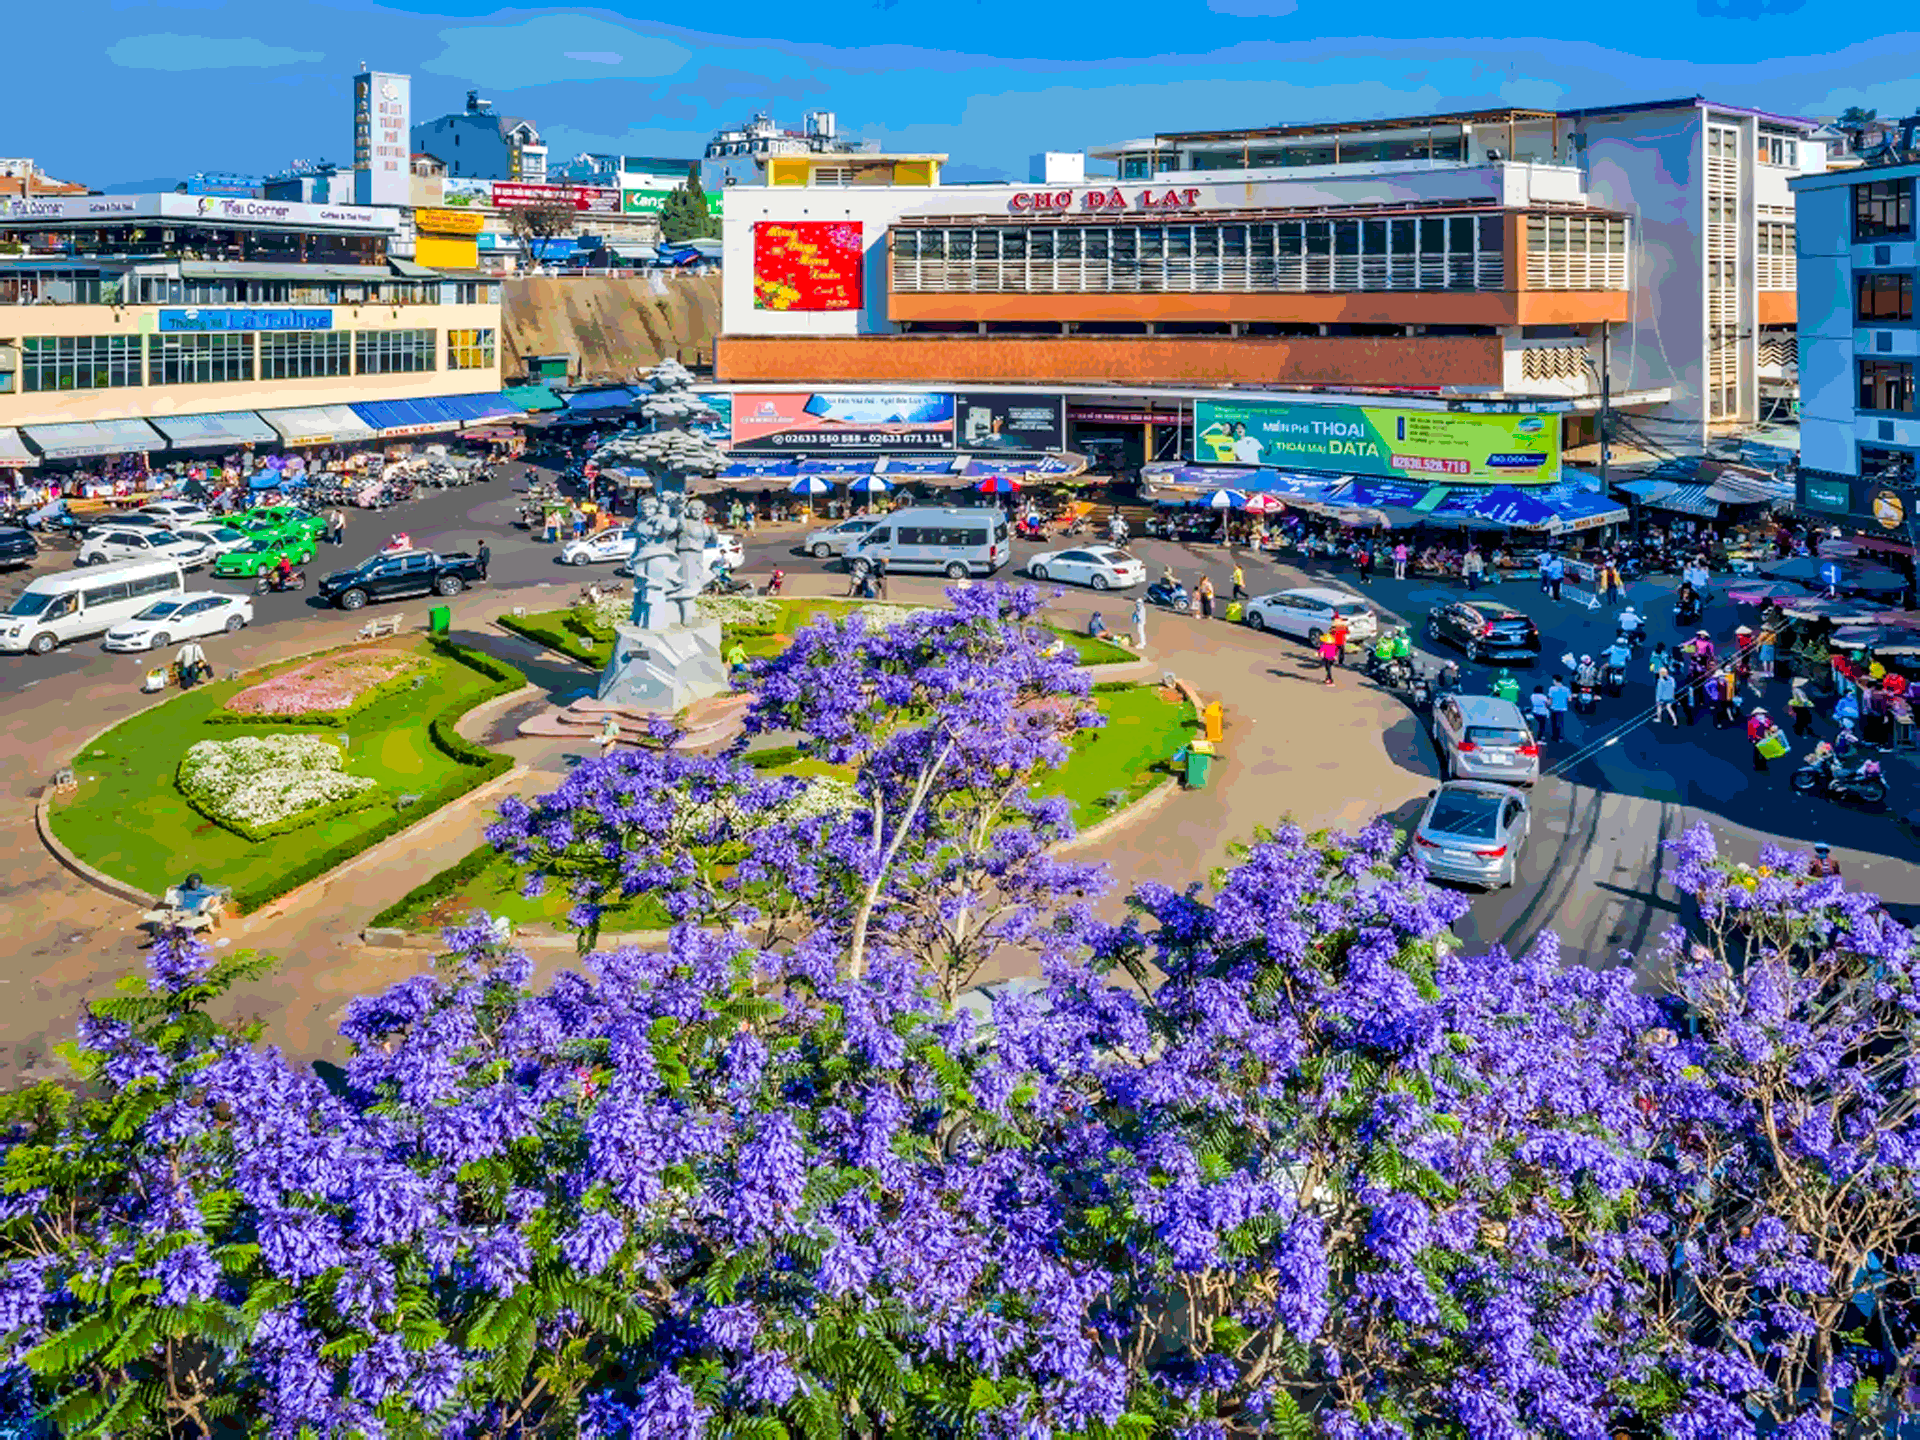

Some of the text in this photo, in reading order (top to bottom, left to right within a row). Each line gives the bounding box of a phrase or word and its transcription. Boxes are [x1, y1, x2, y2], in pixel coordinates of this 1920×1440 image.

[1012, 188, 1073, 211] CHỢ
[1086, 186, 1127, 208] ĐÀ
[1329, 440, 1379, 457] DATA
